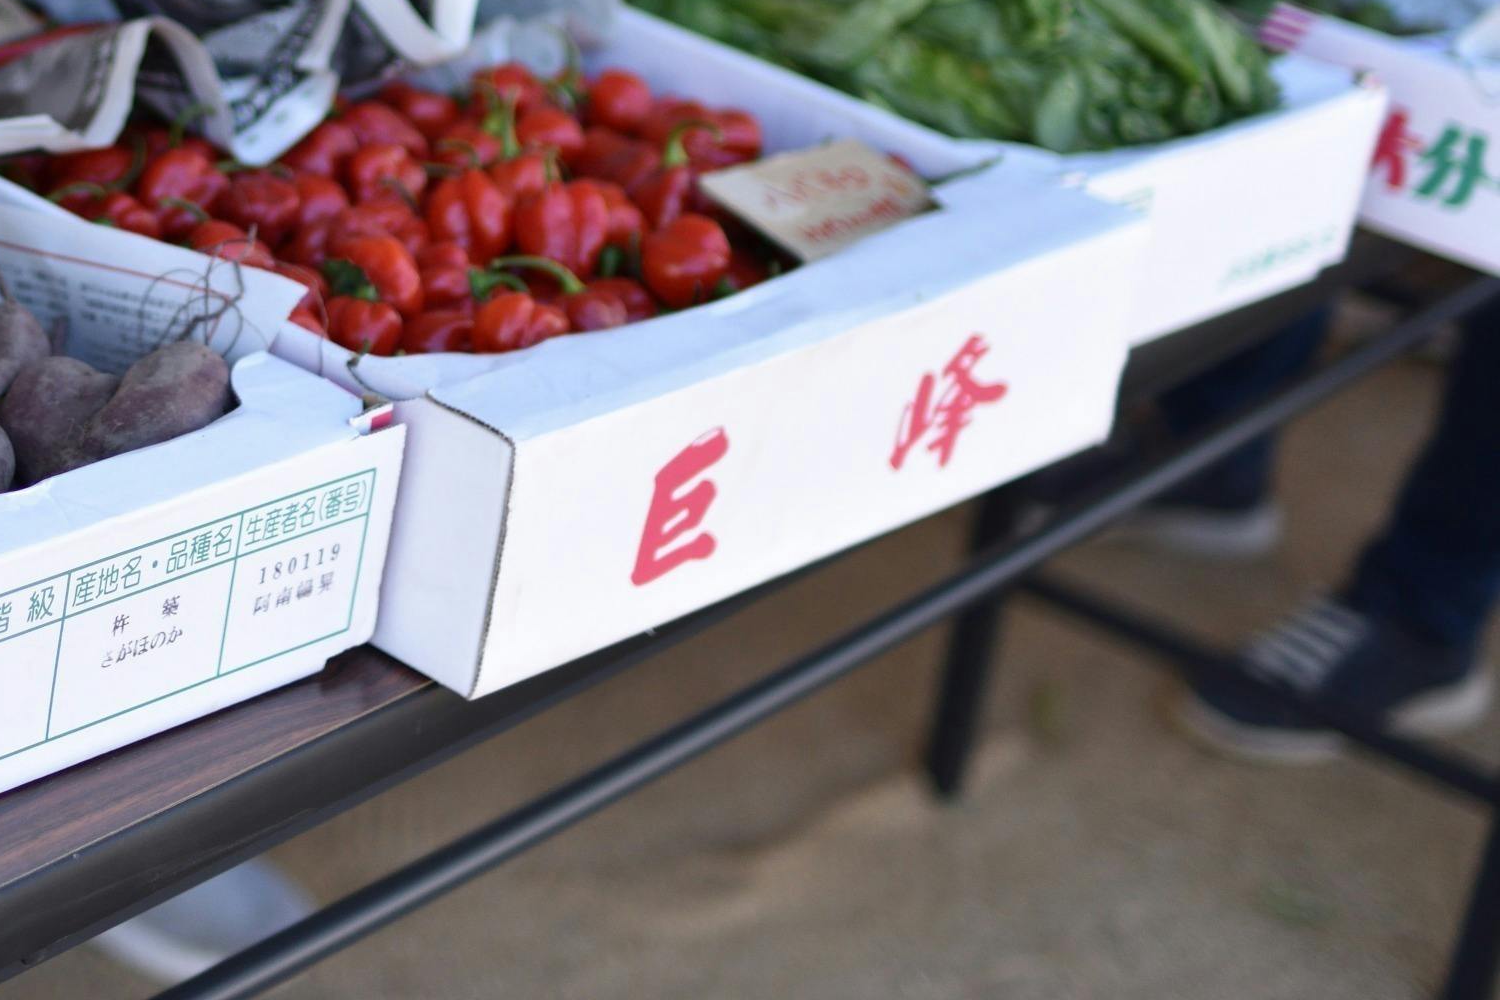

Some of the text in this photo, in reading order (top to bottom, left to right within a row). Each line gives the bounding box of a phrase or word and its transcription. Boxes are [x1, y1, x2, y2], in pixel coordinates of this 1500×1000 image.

[244, 479, 368, 547] 生産者名(番号)
[71, 523, 234, 608] 産地名・品種名
[258, 543, 341, 585] 180119
[100, 625, 184, 668] さがほのか
